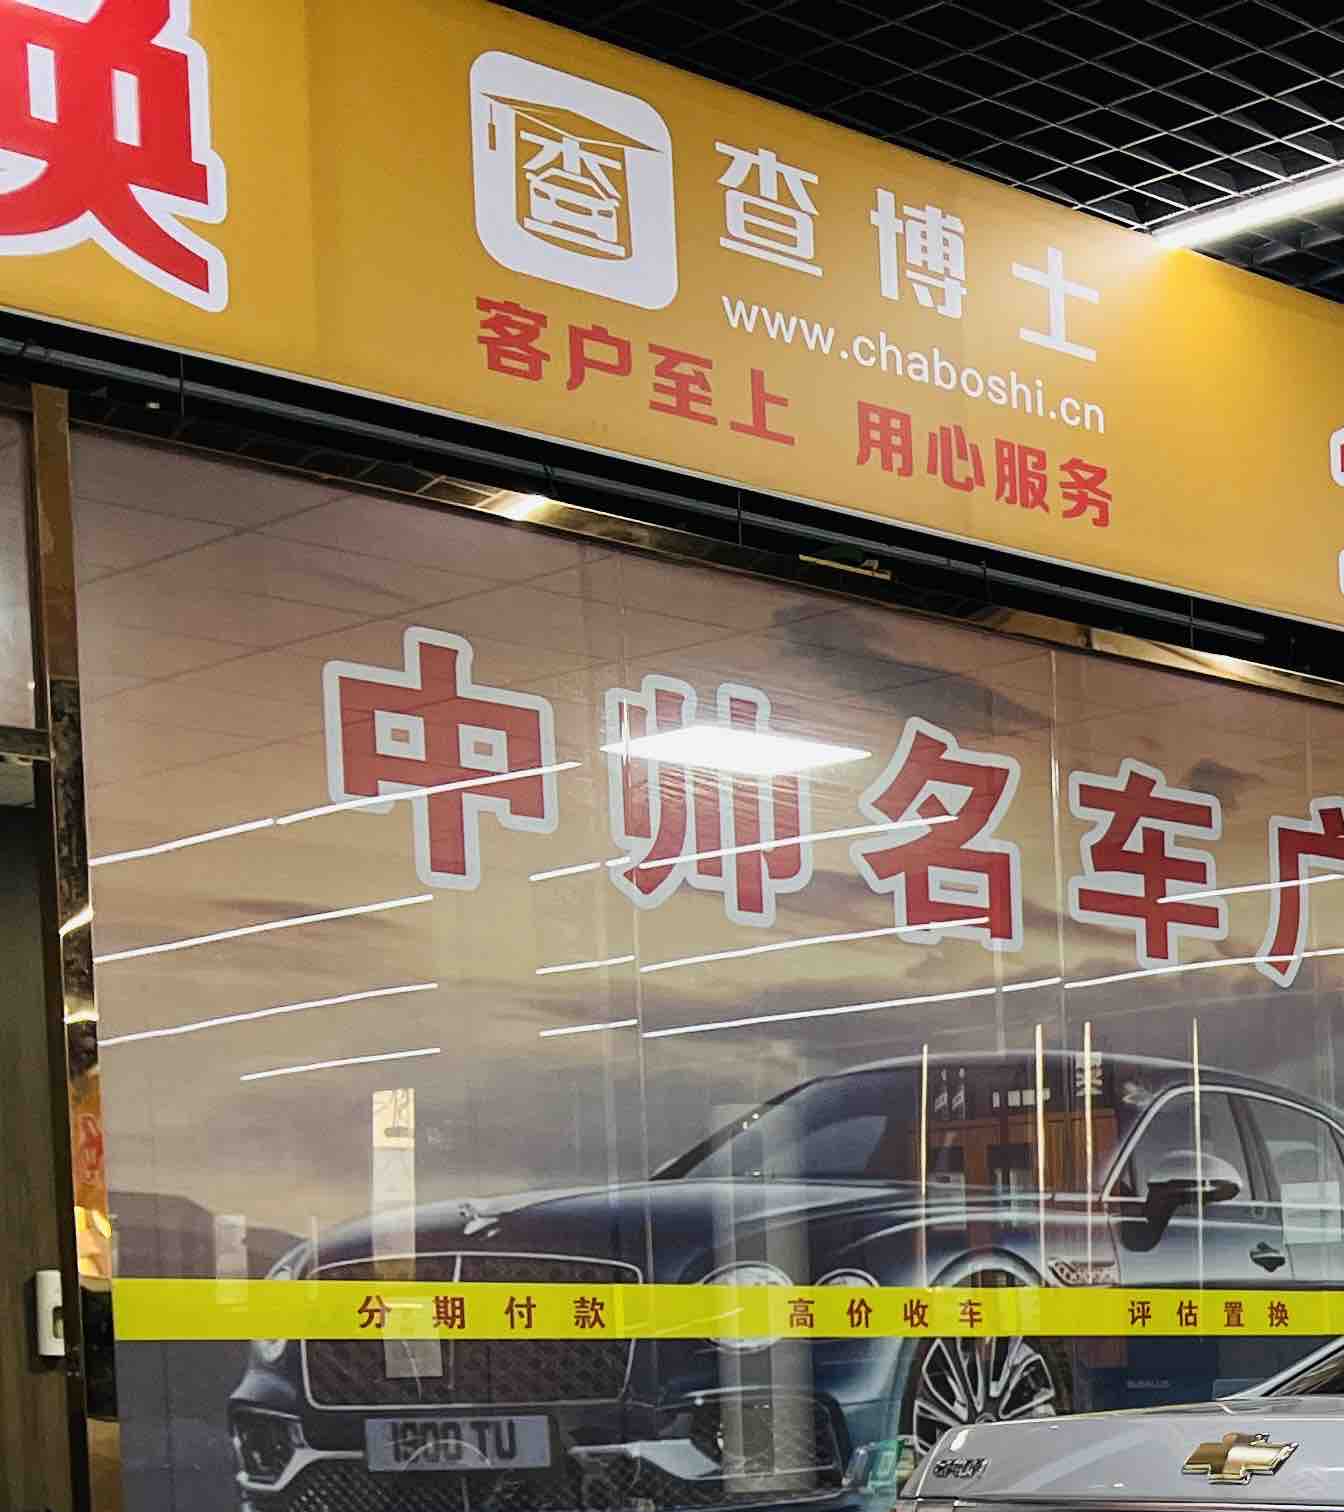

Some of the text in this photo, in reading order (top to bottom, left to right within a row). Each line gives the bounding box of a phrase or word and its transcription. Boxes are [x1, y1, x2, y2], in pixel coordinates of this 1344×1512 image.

[713, 141, 1099, 362] 查博士
[475, 297, 1114, 529] 客户至上 用心服务
[721, 295, 1106, 434] www.chaboshi.cn
[357, 1295, 1290, 1331] 分期付款 高价收车 评估置换
